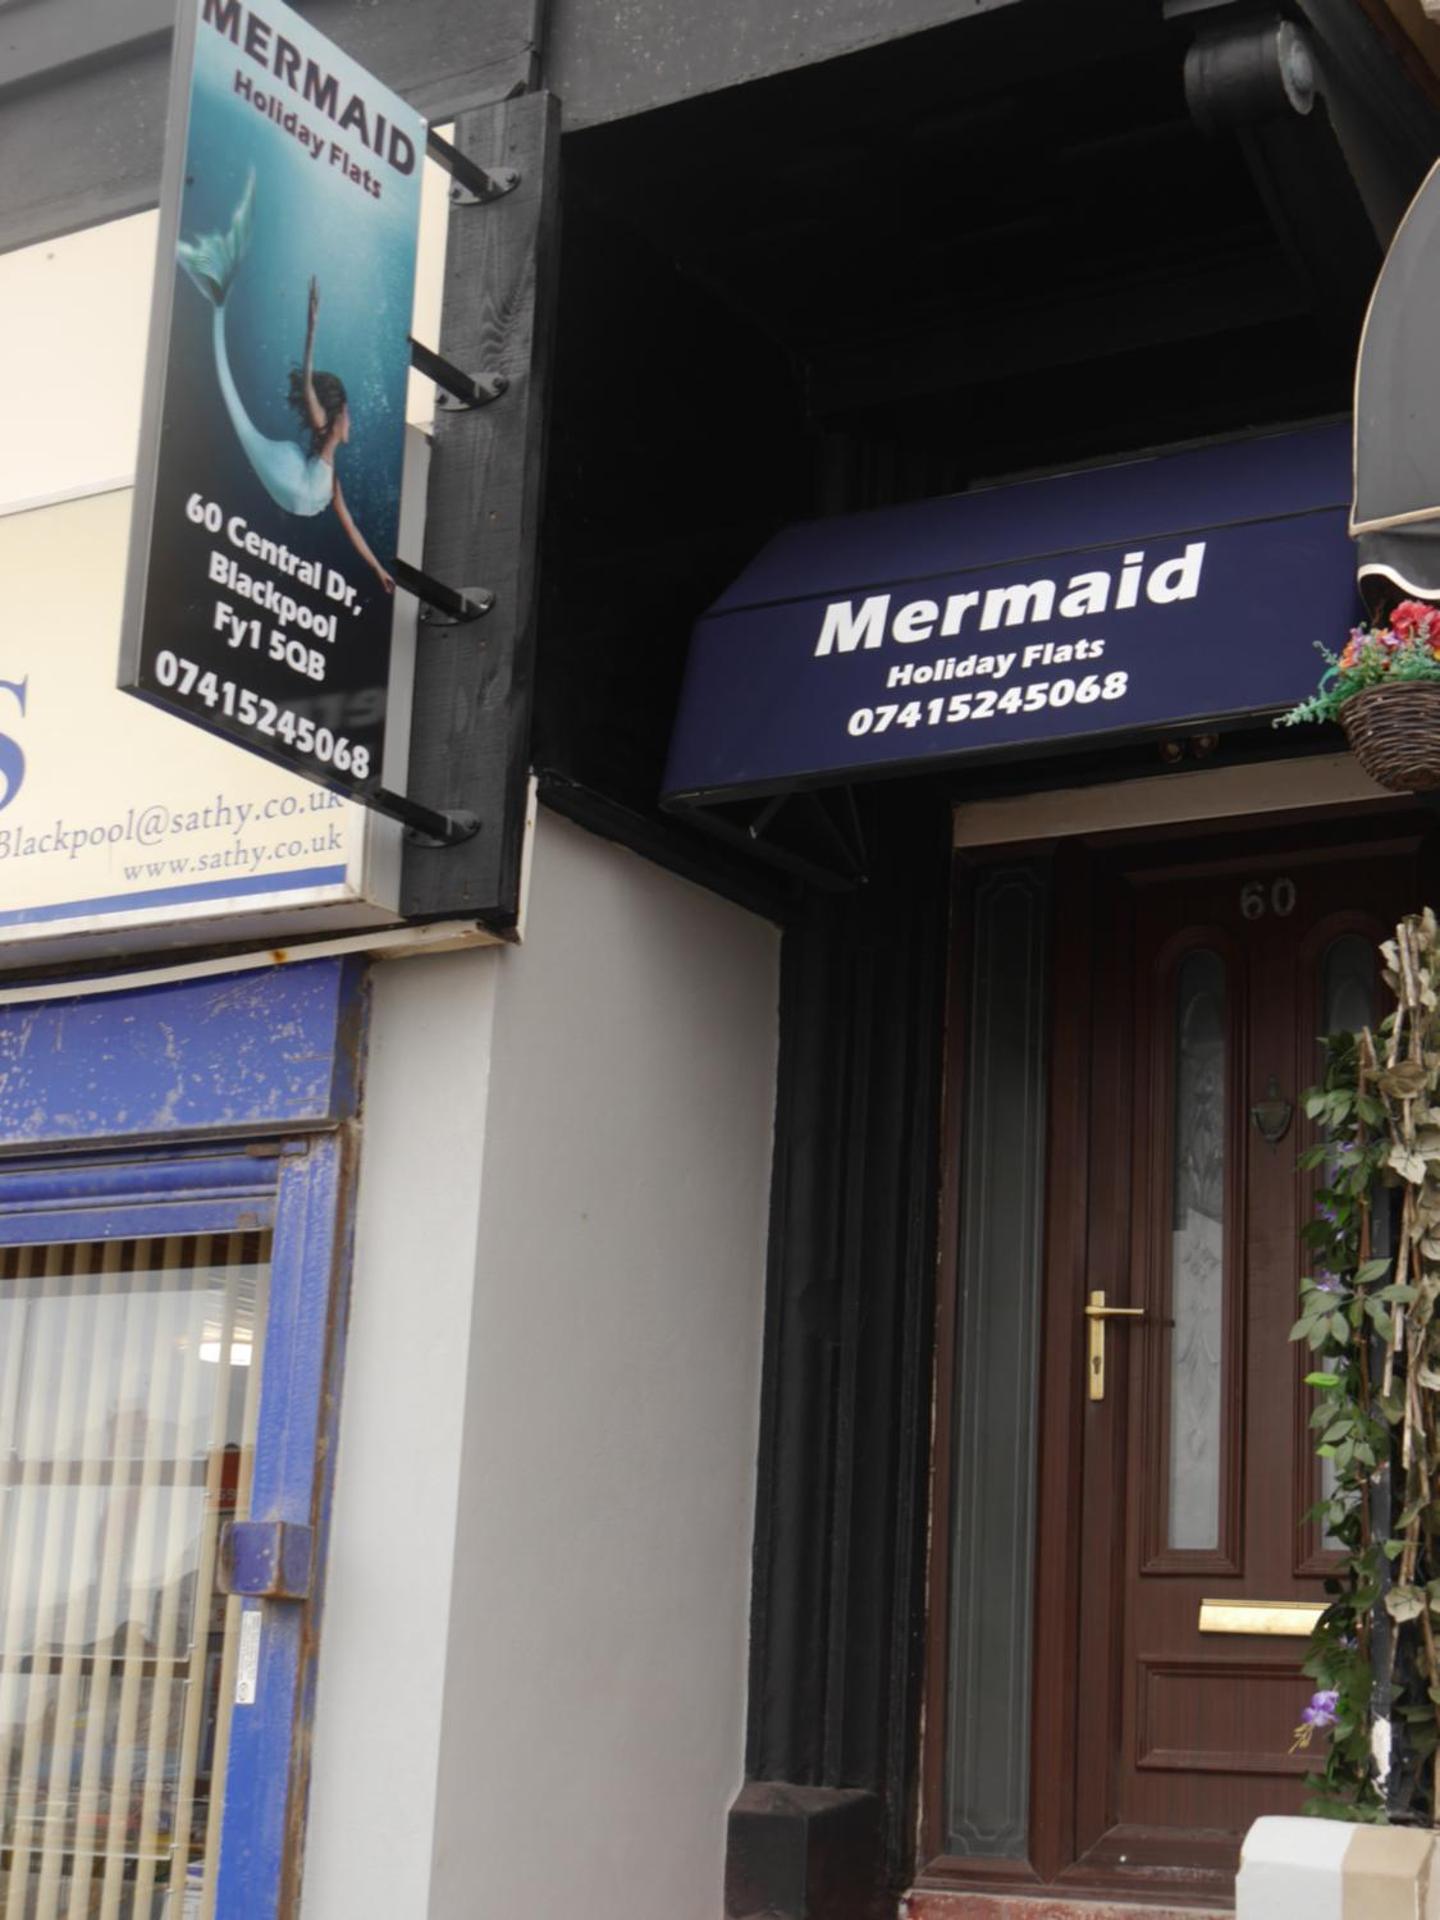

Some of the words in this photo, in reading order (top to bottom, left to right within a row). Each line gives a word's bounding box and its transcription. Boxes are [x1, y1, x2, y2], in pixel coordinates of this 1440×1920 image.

[202, 0, 415, 176] MERMAID
[233, 69, 325, 158] Holiday
[329, 144, 382, 199] Flats
[186, 493, 223, 533] 60
[227, 516, 320, 590] Central
[326, 569, 361, 617] Dr,
[208, 550, 337, 643] Blackpool
[814, 541, 1206, 657] Mermaid
[213, 601, 261, 649] Fy1
[269, 632, 326, 682] 5QB
[886, 649, 1016, 689] Holiday
[1021, 638, 1105, 669] Flats
[155, 650, 370, 779] 07415245068
[847, 671, 1129, 737] 07415245068
[123, 823, 344, 881] www.sathy.co.uk
[1240, 877, 1296, 920] 60
